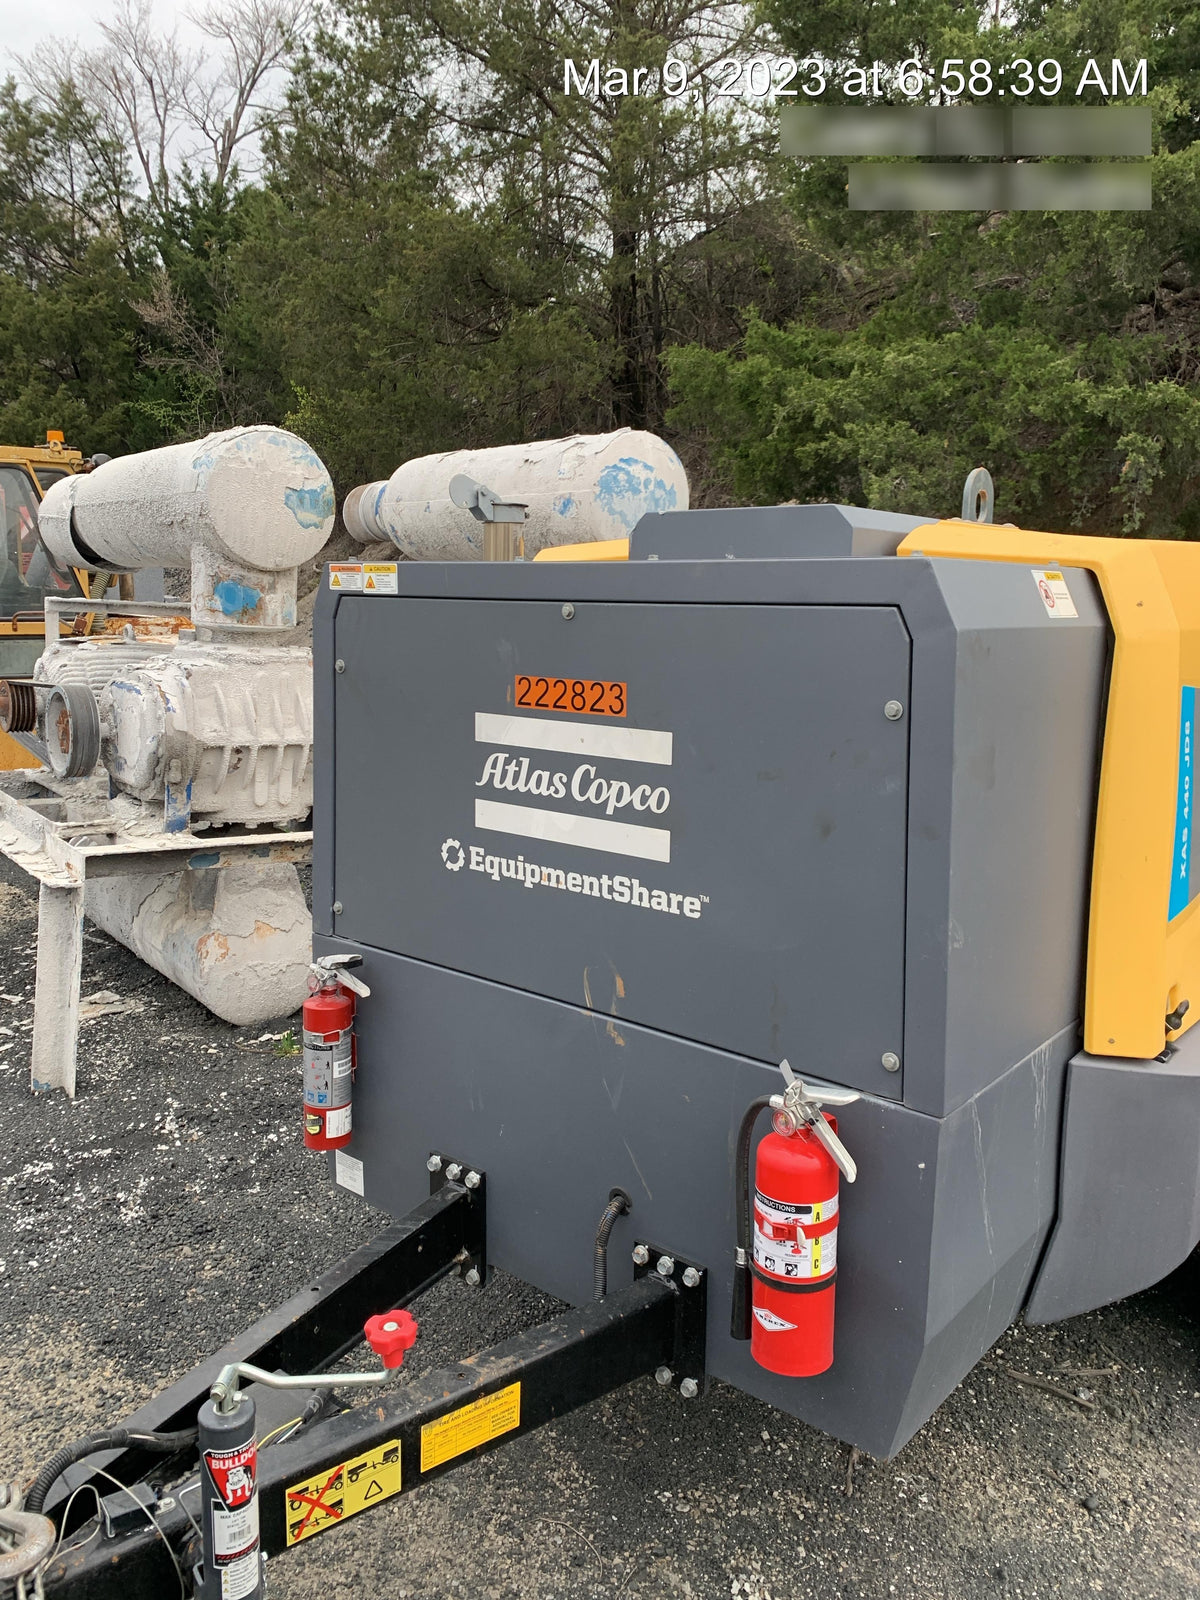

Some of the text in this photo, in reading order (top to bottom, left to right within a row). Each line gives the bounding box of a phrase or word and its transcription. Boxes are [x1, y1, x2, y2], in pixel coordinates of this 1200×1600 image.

[517, 676, 626, 715] 222823
[475, 752, 671, 815] Atlas Copco
[1180, 826, 1188, 879] XAS
[756, 1194, 796, 1213] INSTRUCTIONS
[815, 1211, 821, 1222] A
[814, 1258, 819, 1269] C
[439, 1419, 450, 1427] TIRE
[451, 1414, 461, 1423] AND
[461, 1404, 483, 1418] LOADING
